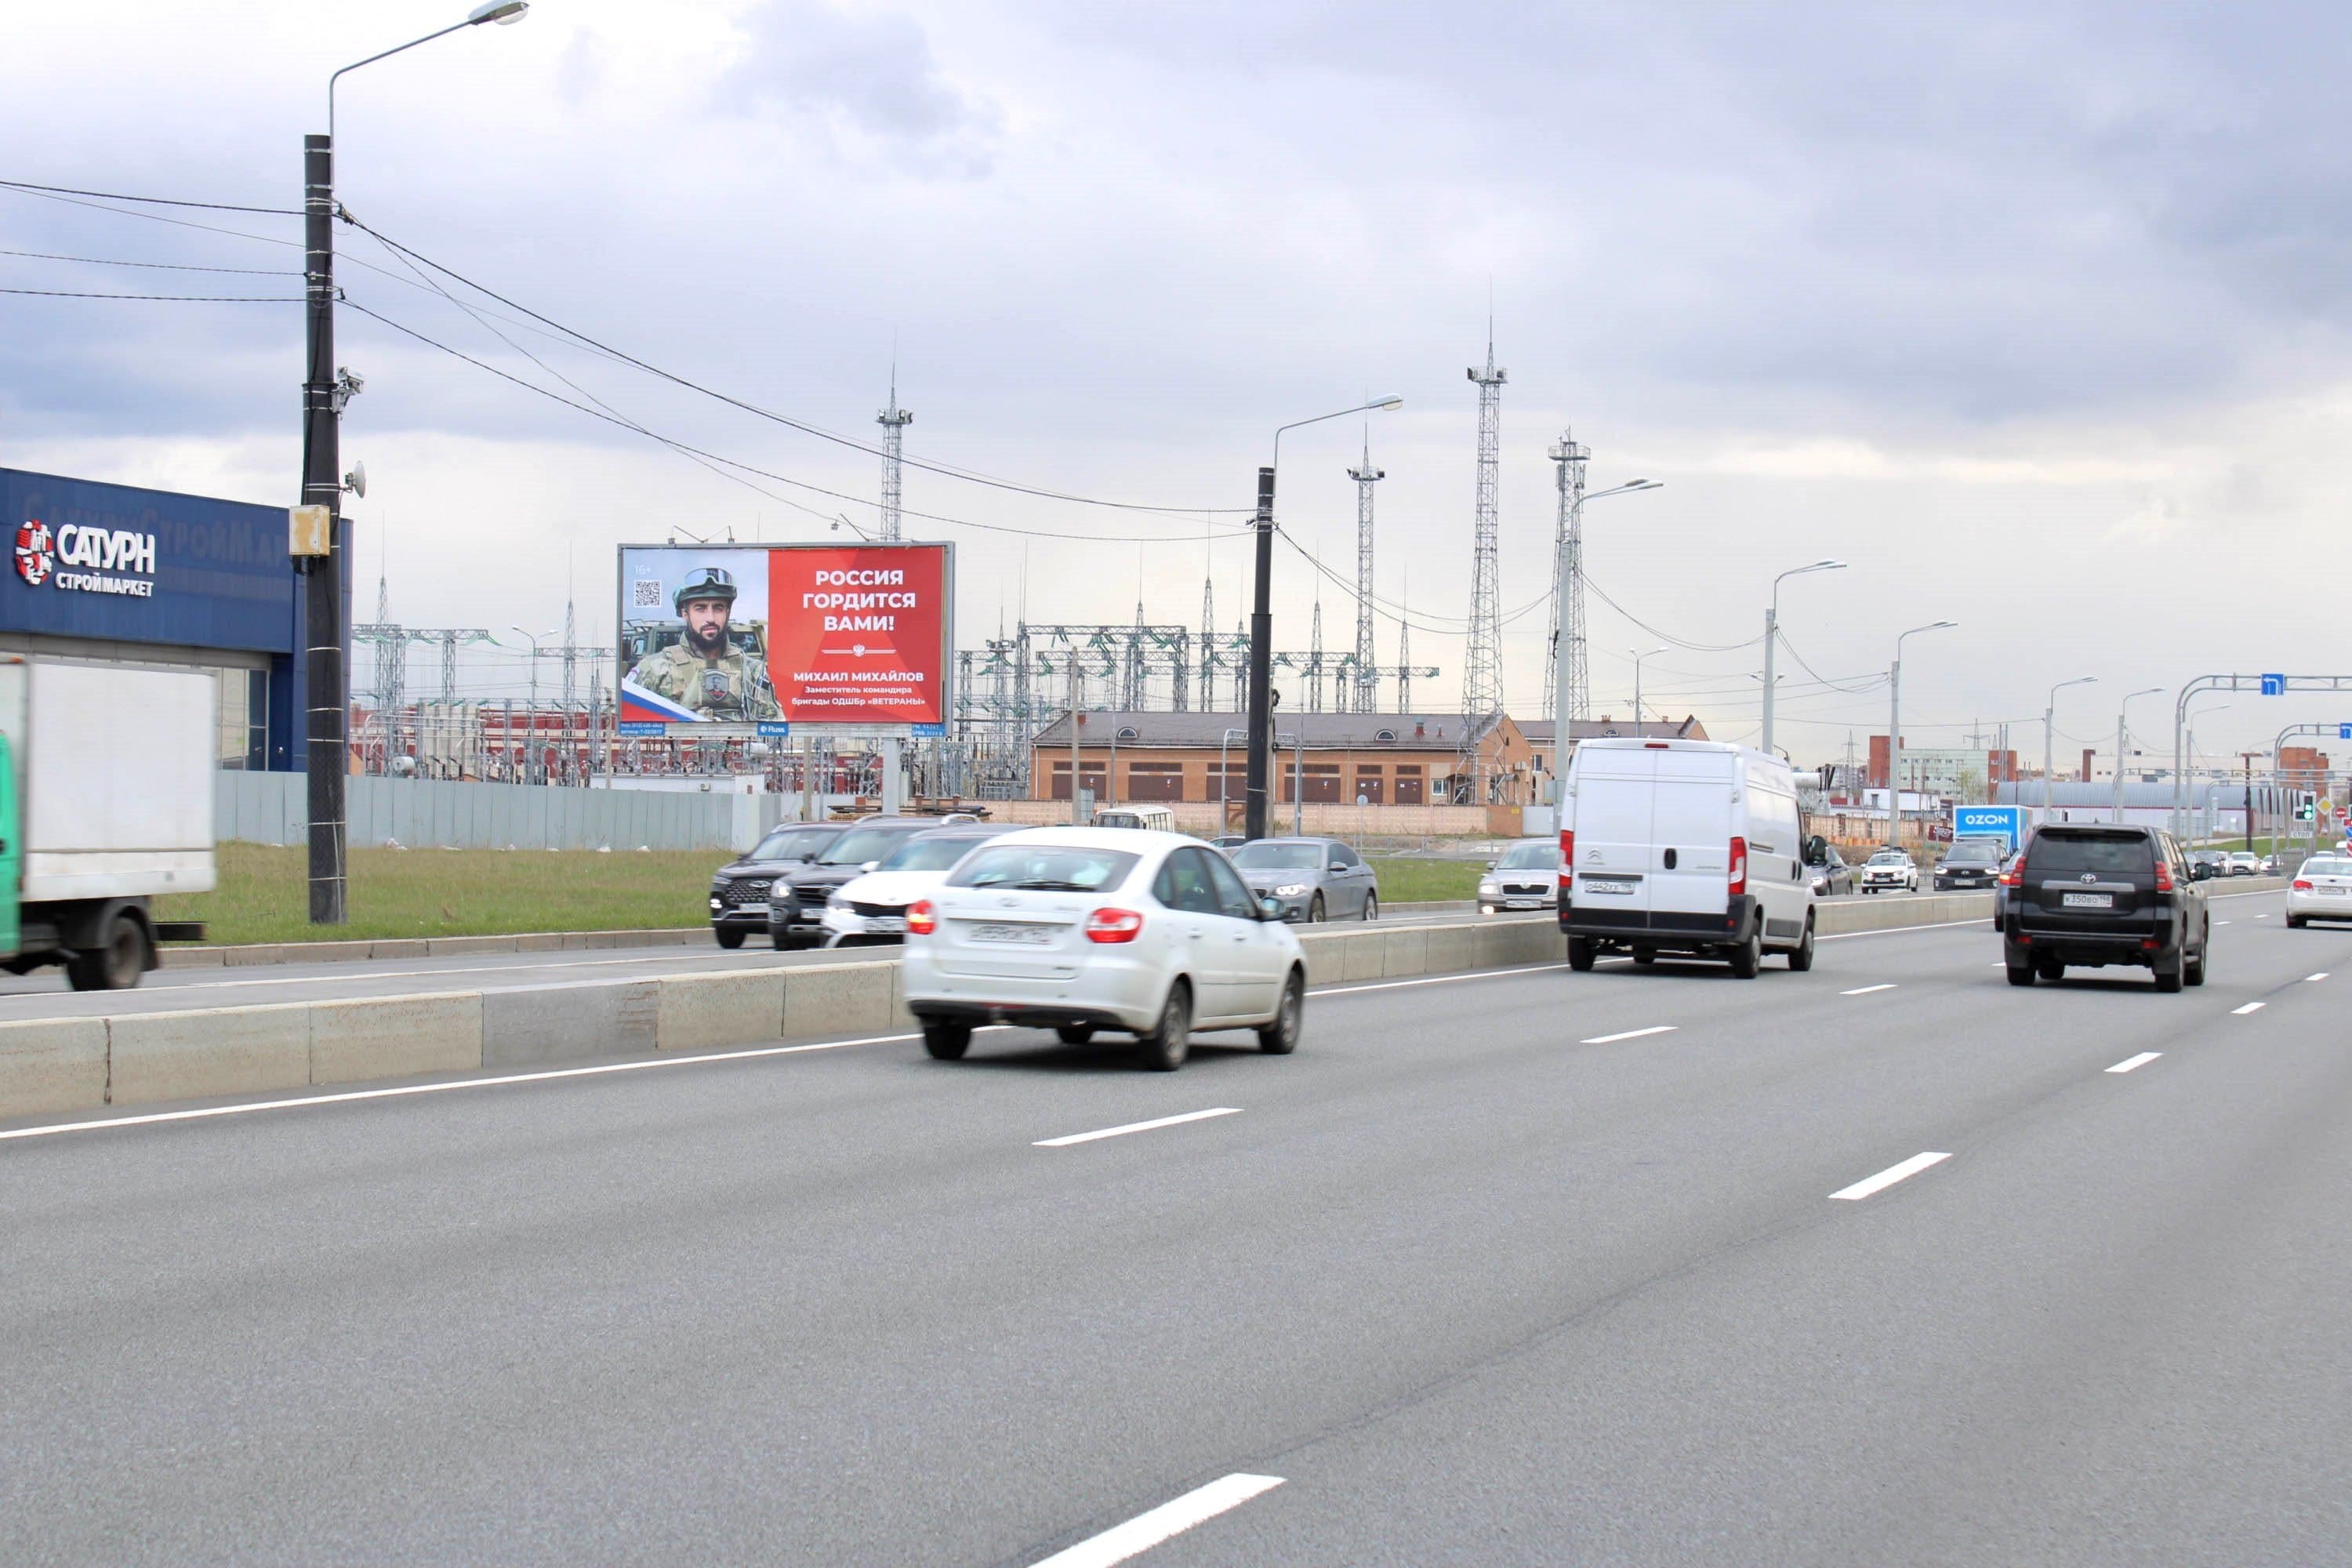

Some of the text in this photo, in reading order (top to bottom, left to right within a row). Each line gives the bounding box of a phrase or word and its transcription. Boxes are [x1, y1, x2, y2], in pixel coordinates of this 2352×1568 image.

[56, 524, 155, 574] САТУРН
[56, 572, 154, 597] СТРОЙМАРКЕТ
[815, 570, 904, 586] РОССИЯ
[803, 592, 916, 611] ГОРДИТСЯ
[824, 615, 895, 631] ВАМИ!
[793, 670, 924, 682] МИХАИЛ МИХАЙЛОВ
[791, 697, 926, 706] бригады ОДШБр «ВЕТЕРАНЫ»
[1965, 815, 2009, 825] OZON
